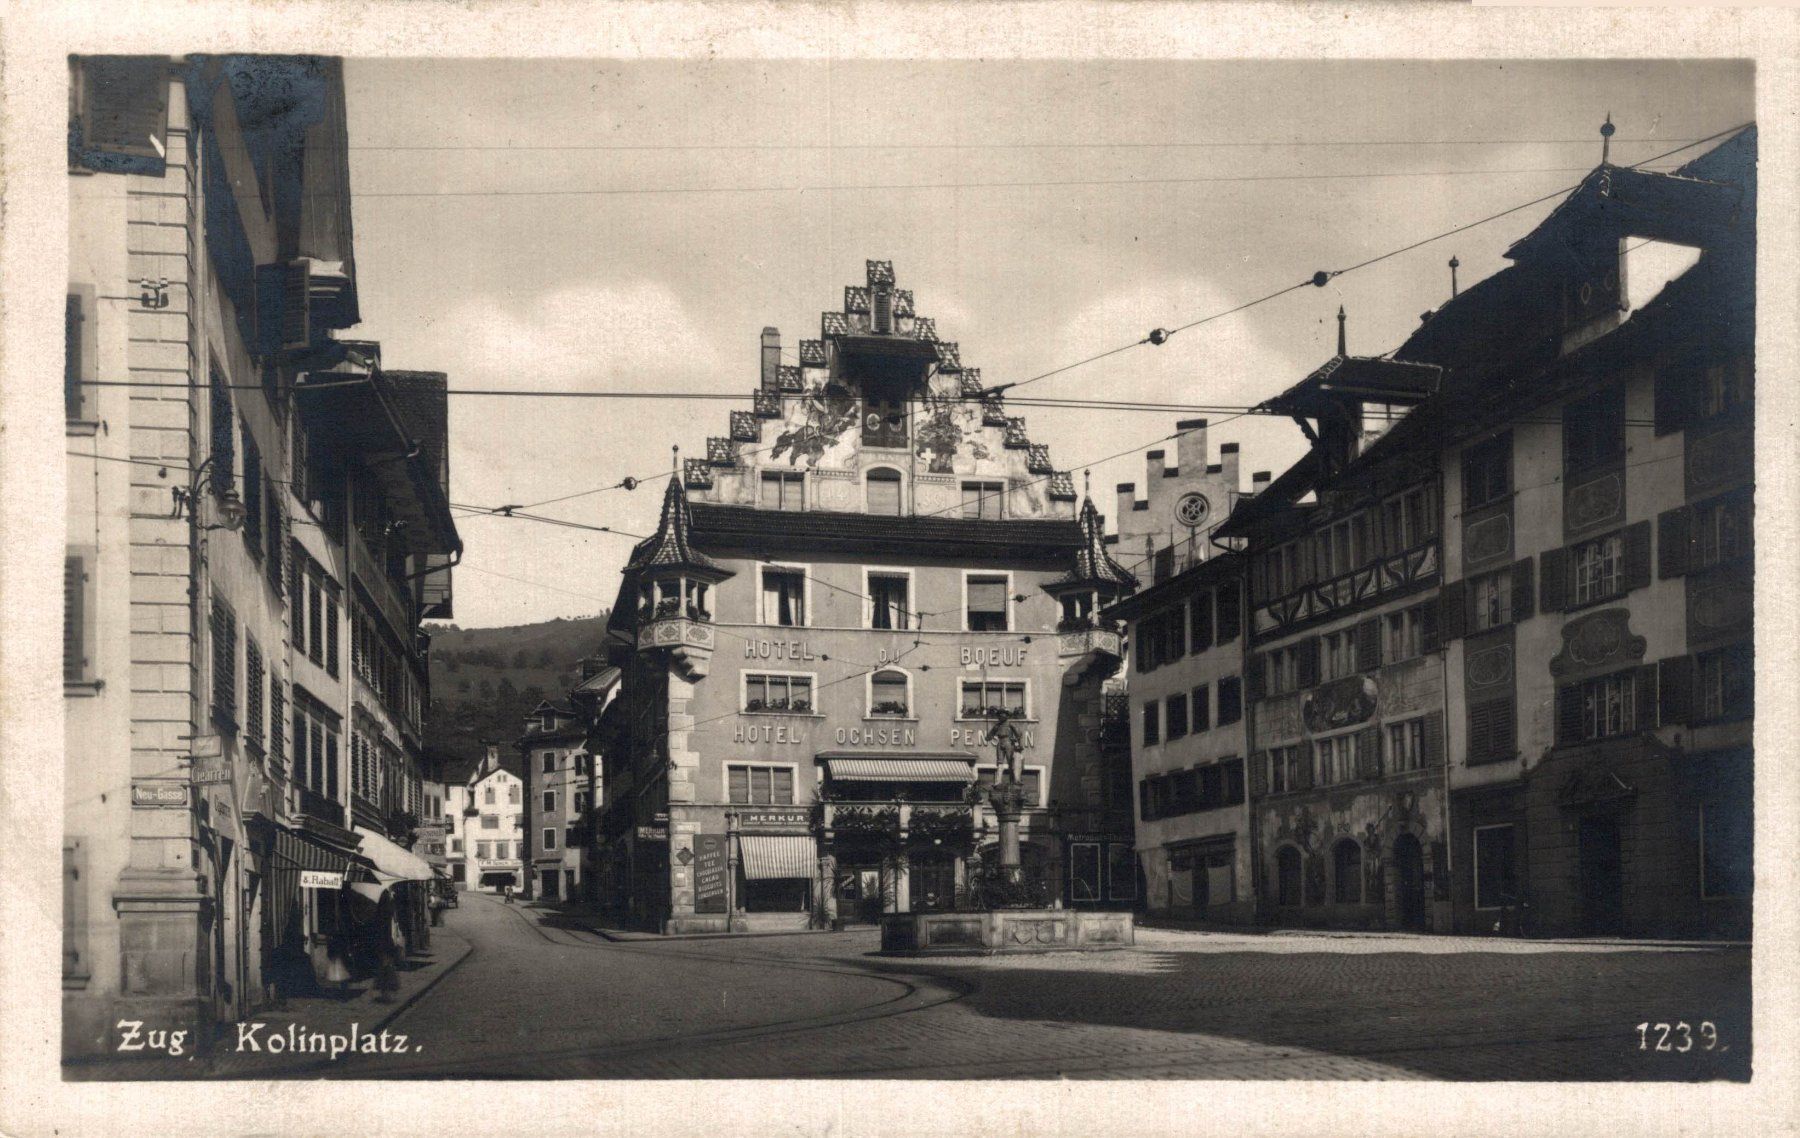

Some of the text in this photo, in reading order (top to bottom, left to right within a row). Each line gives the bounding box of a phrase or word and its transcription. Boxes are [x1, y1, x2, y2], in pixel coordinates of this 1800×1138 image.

[745, 640, 1028, 667] HOTEL DU BOEUF
[733, 724, 1035, 748] HOTEL OCHSEN PENSN
[136, 787, 183, 801] Neu-Gasse
[704, 860, 716, 868] TEE
